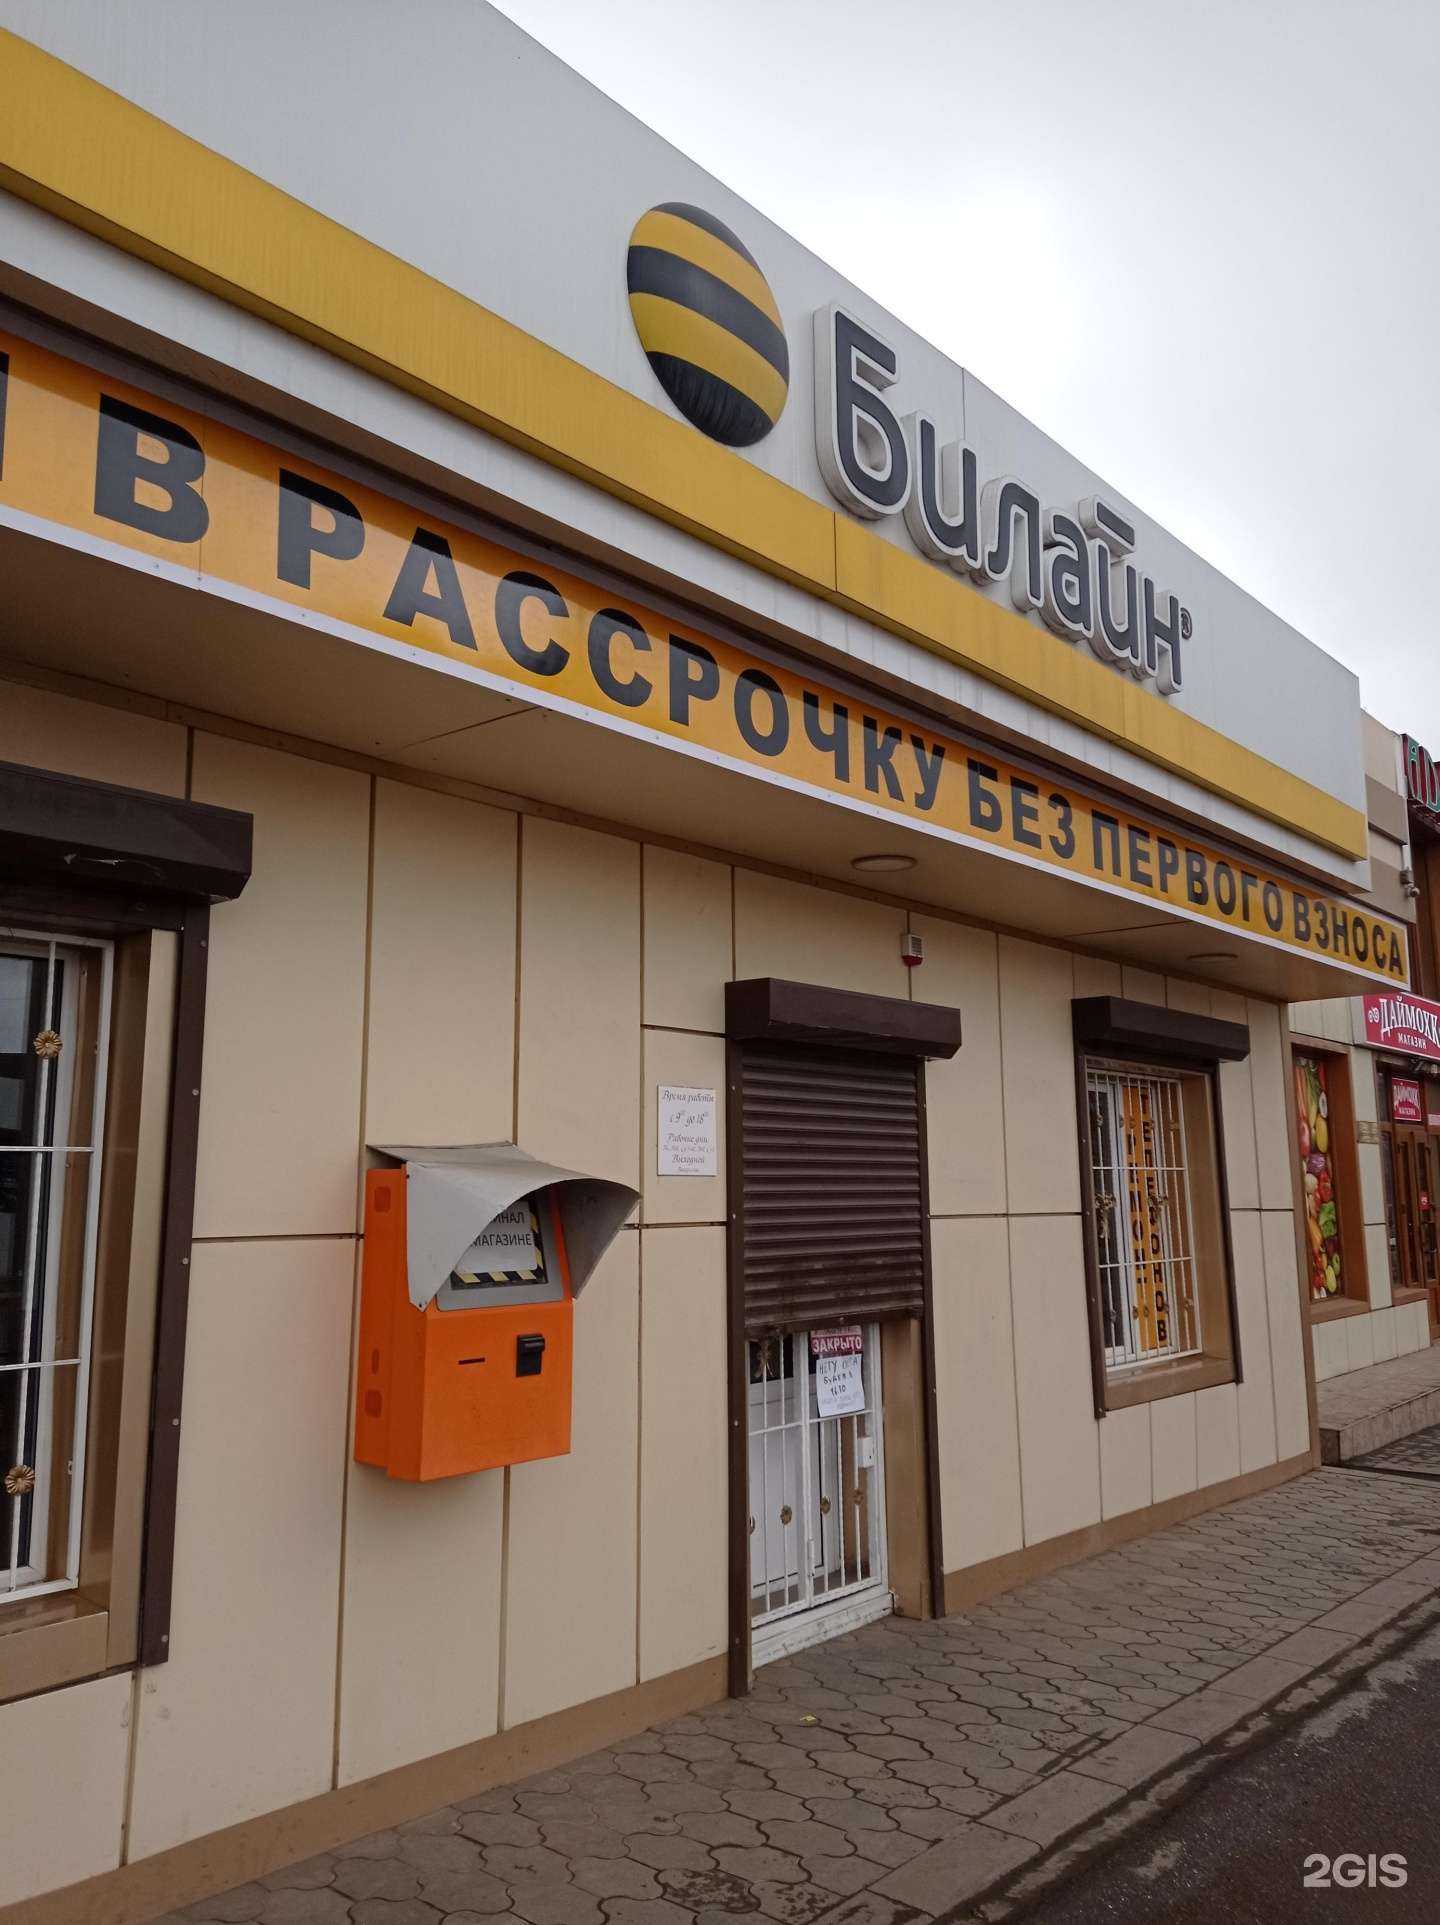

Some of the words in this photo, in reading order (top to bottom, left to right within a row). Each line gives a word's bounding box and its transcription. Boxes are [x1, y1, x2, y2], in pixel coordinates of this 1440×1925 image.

[814, 304, 1184, 694] Билайн
[94, 393, 209, 544] В
[277, 468, 945, 810] РАССРОЧКУ
[967, 758, 1075, 859] БЕЗ
[1091, 809, 1283, 932] ПЕРВОГО
[1293, 891, 1404, 976] ВЗНОСА
[1398, 1032, 1427, 1049] МАГАЗИН
[812, 1336, 862, 1353] ЗАКРЫТО
